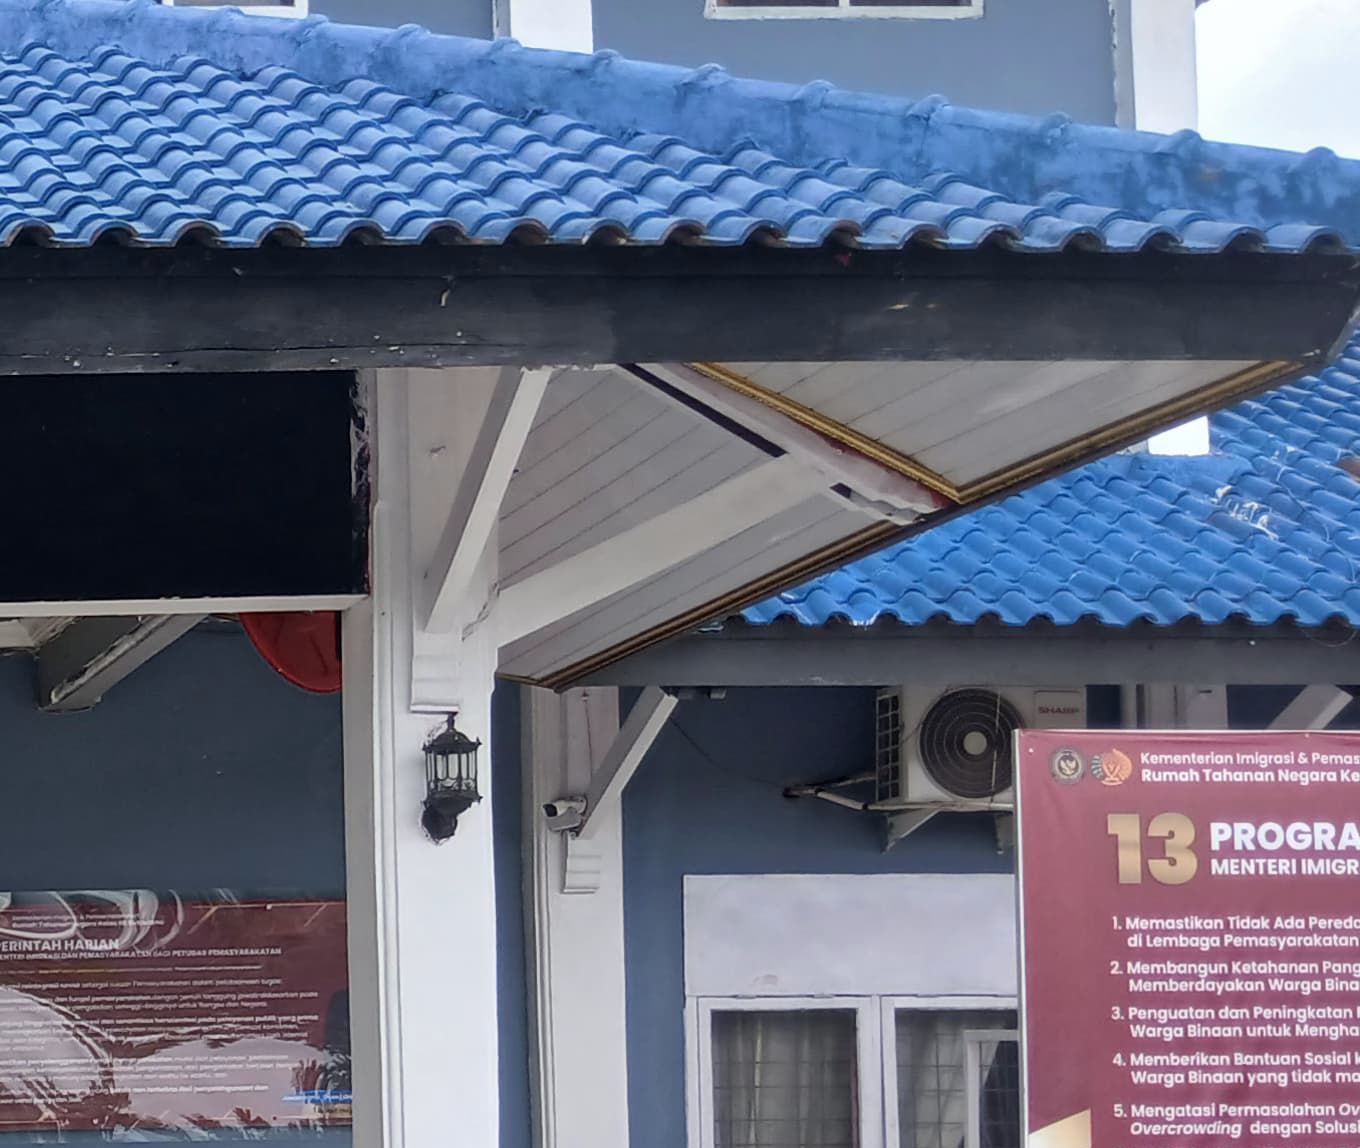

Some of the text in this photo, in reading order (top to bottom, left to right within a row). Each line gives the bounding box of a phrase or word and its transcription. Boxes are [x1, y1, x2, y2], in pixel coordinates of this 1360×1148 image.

[1140, 752, 1360, 768] Kementerian Imigrasi & Pemas
[1141, 769, 1360, 785] Rumah Tahanan Negara Ke
[1210, 822, 1360, 851] PROGRA
[1107, 812, 1198, 884] 13
[1211, 859, 1360, 875] MENTERI IMIGR
[1112, 916, 1122, 930] 1.
[1125, 916, 1224, 930] Memastikan
[1227, 916, 1270, 929] Tidak
[1274, 916, 1305, 929] Ada
[64, 939, 120, 951] HARIAN
[1127, 933, 1359, 951] di Lembaga Pemasyarakatan
[1110, 961, 1123, 974] 2.
[1127, 961, 1228, 978] Membangun
[1231, 961, 1319, 974] Ketahanan
[1129, 979, 1265, 995] Memberdayakan
[1268, 979, 1321, 995] Warga
[1111, 1006, 1125, 1020] 3.
[1128, 1006, 1215, 1024] Penguatan
[1218, 1006, 1249, 1020] dan
[1253, 1005, 1353, 1023] Peningkatan
[1130, 1024, 1184, 1041] Warga
[1187, 1024, 1242, 1037] Binaan
[1246, 1023, 1291, 1037] untuk
[1112, 1053, 1126, 1066] 4.
[1130, 1052, 1230, 1066] Memberikan
[1234, 1052, 1301, 1065] Bantuan
[1304, 1051, 1351, 1065] Sosial
[1131, 1071, 1185, 1088] Warga
[1188, 1070, 1244, 1084] Binaan
[1247, 1072, 1288, 1087] yang
[1291, 1069, 1331, 1083] tidak
[1113, 1104, 1127, 1118] 5.
[1131, 1104, 1216, 1121] Mengatasi
[1219, 1103, 1335, 1117] Permasalahan
[1130, 1121, 1242, 1138] Overcrowding
[1250, 1121, 1312, 1138] dengan
